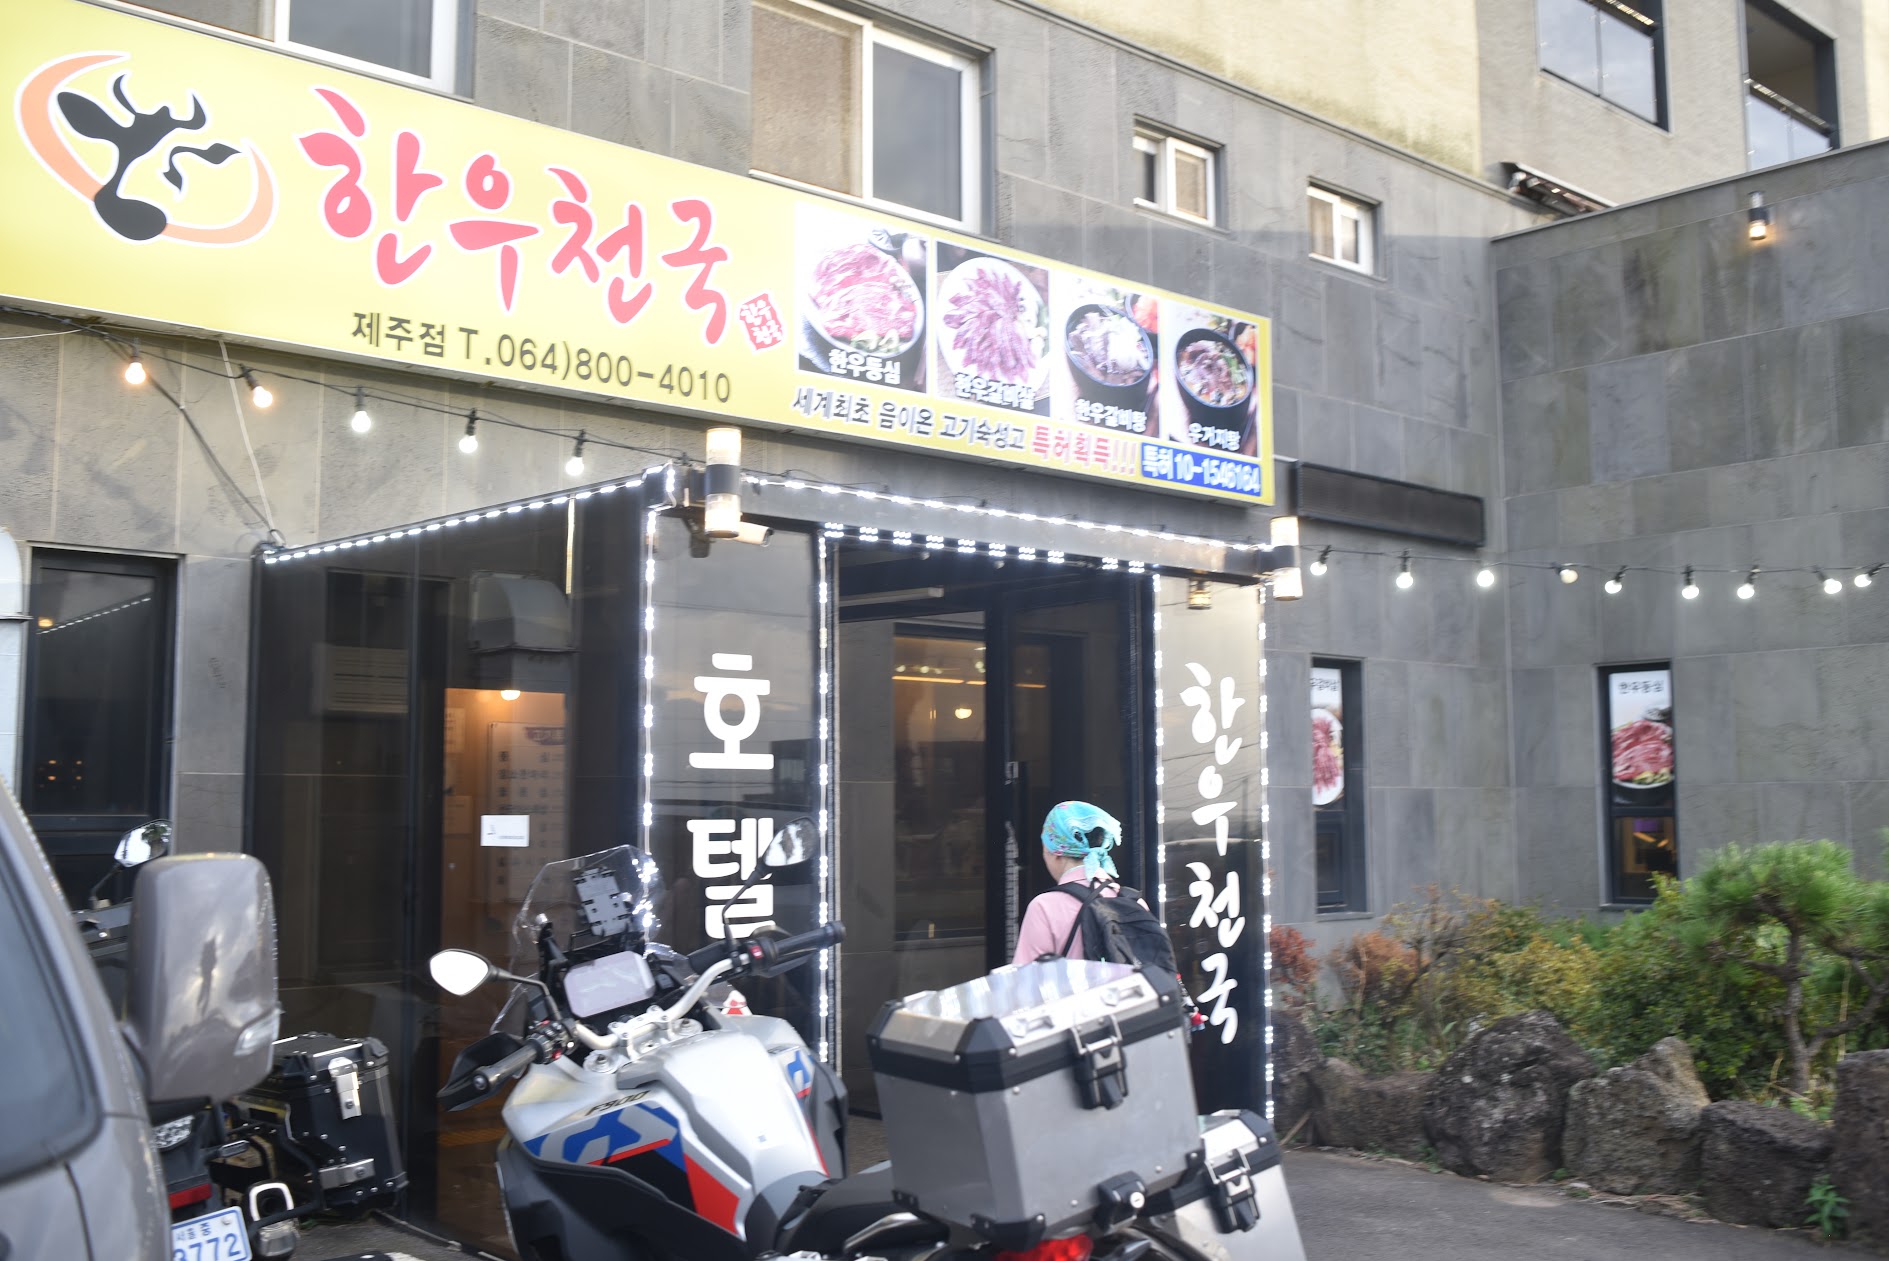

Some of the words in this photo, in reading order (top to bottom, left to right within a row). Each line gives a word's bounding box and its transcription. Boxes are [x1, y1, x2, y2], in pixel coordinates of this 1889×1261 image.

[300, 88, 729, 345] 한우천국
[352, 312, 445, 358] 제주점
[828, 348, 900, 385] 한우등심
[792, 387, 871, 424] 세계최초
[879, 402, 933, 435] 음이온
[1142, 444, 1173, 480] 특허
[687, 653, 776, 940] 호텔
[1179, 662, 1246, 1044] 한우천국
